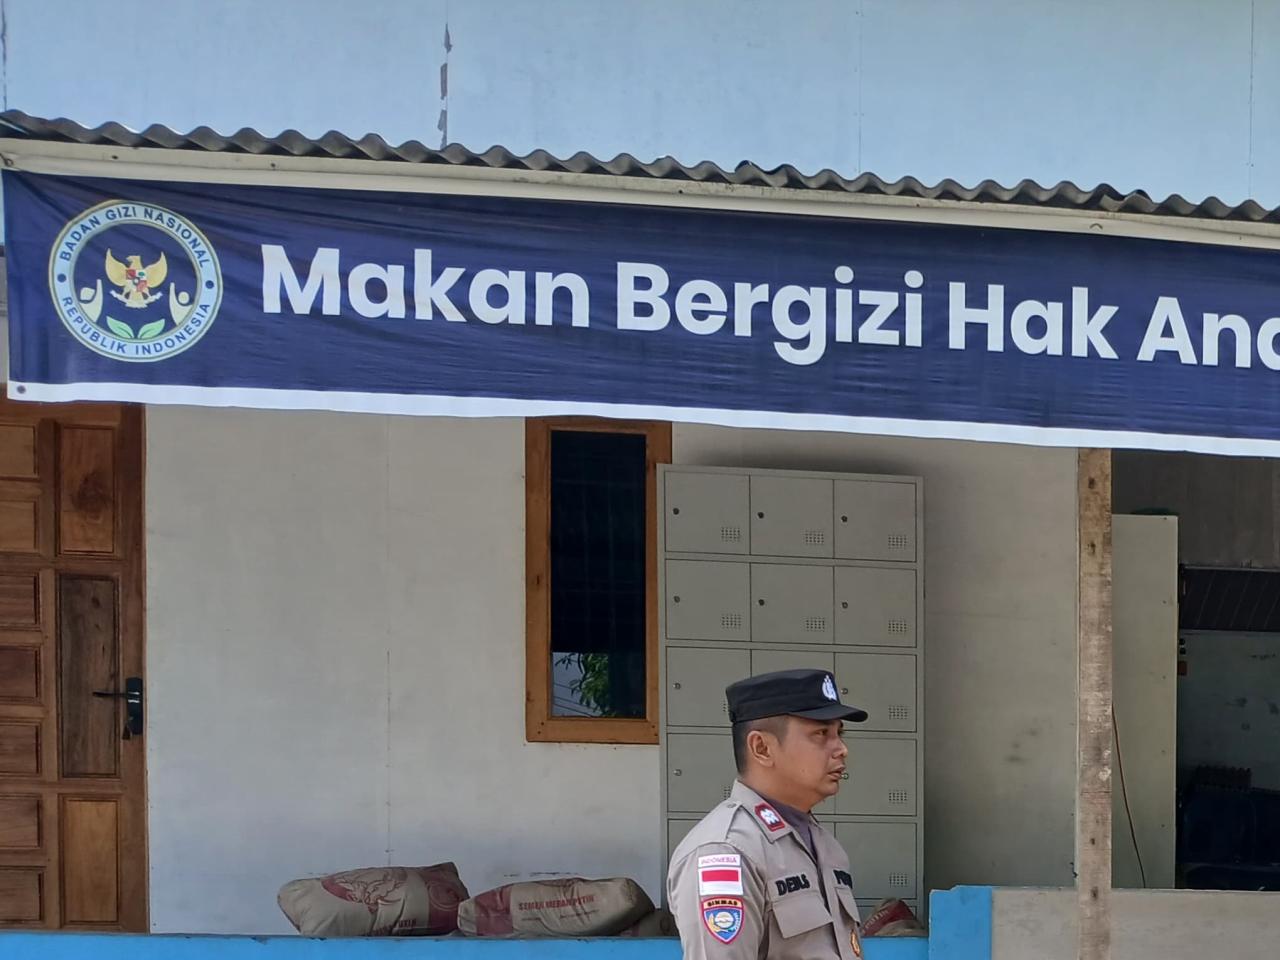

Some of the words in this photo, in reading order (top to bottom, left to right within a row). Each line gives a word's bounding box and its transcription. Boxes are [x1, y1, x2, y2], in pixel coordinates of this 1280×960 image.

[59, 216, 101, 262] BADAN
[105, 206, 137, 221] GIZI
[144, 207, 210, 268] NASIONAL
[62, 296, 127, 354] REPUBLIK
[135, 303, 210, 355] INDONESIA
[261, 243, 591, 328] Makan
[616, 261, 923, 366] Bergizi
[948, 282, 1119, 360] Hak
